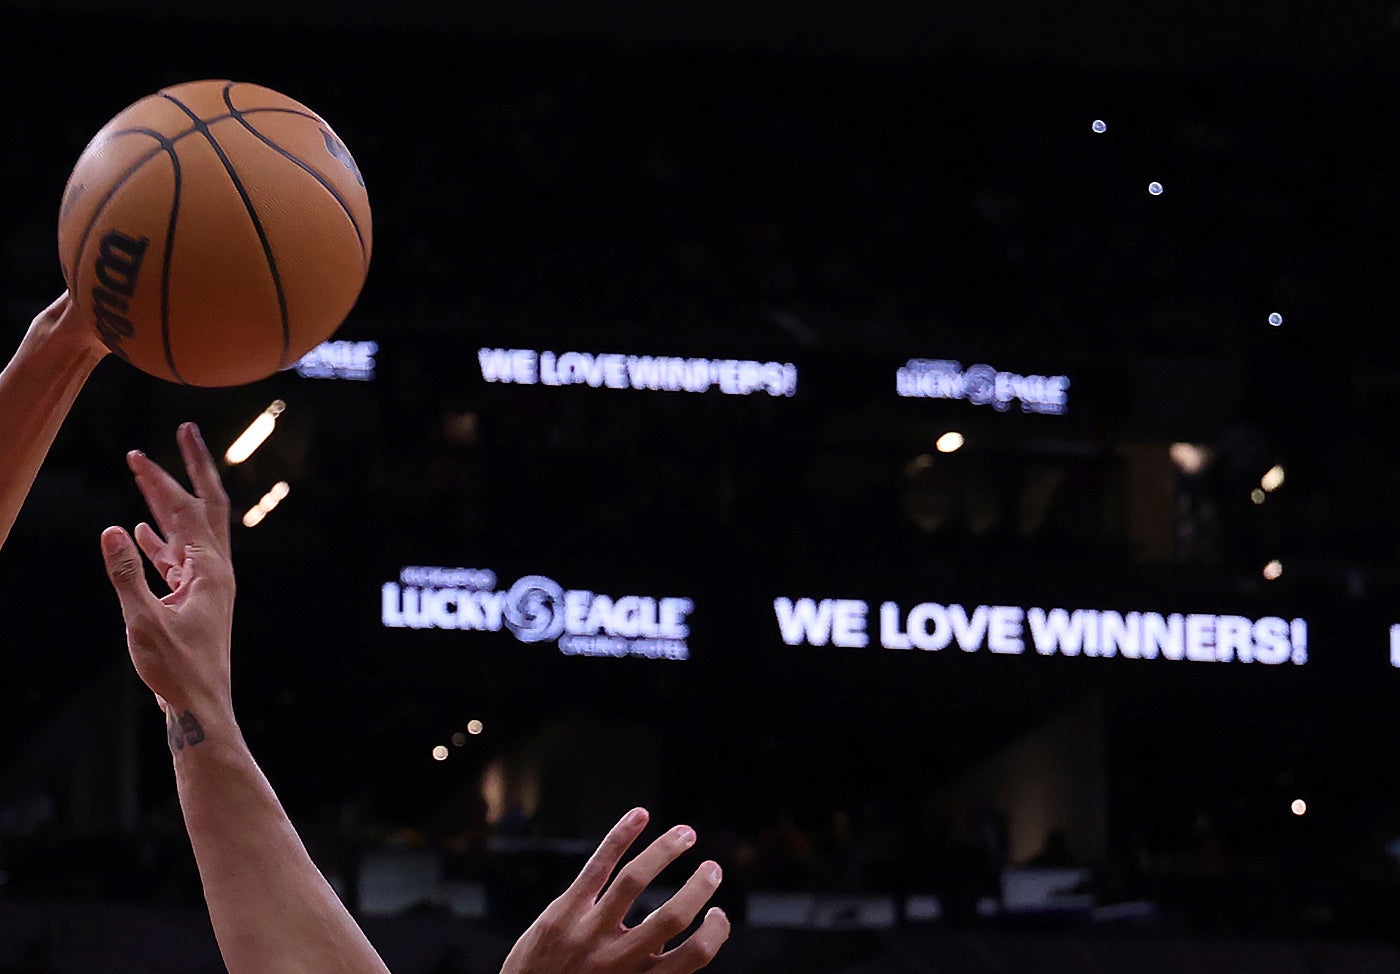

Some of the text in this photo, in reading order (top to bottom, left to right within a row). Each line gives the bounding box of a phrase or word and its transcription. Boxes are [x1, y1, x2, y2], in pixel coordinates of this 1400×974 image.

[478, 347, 538, 384] WE
[540, 350, 630, 389] LOVE
[381, 582, 695, 640] LUCKY EAGLE
[774, 597, 1309, 665] WE LOVE WINNERS!
